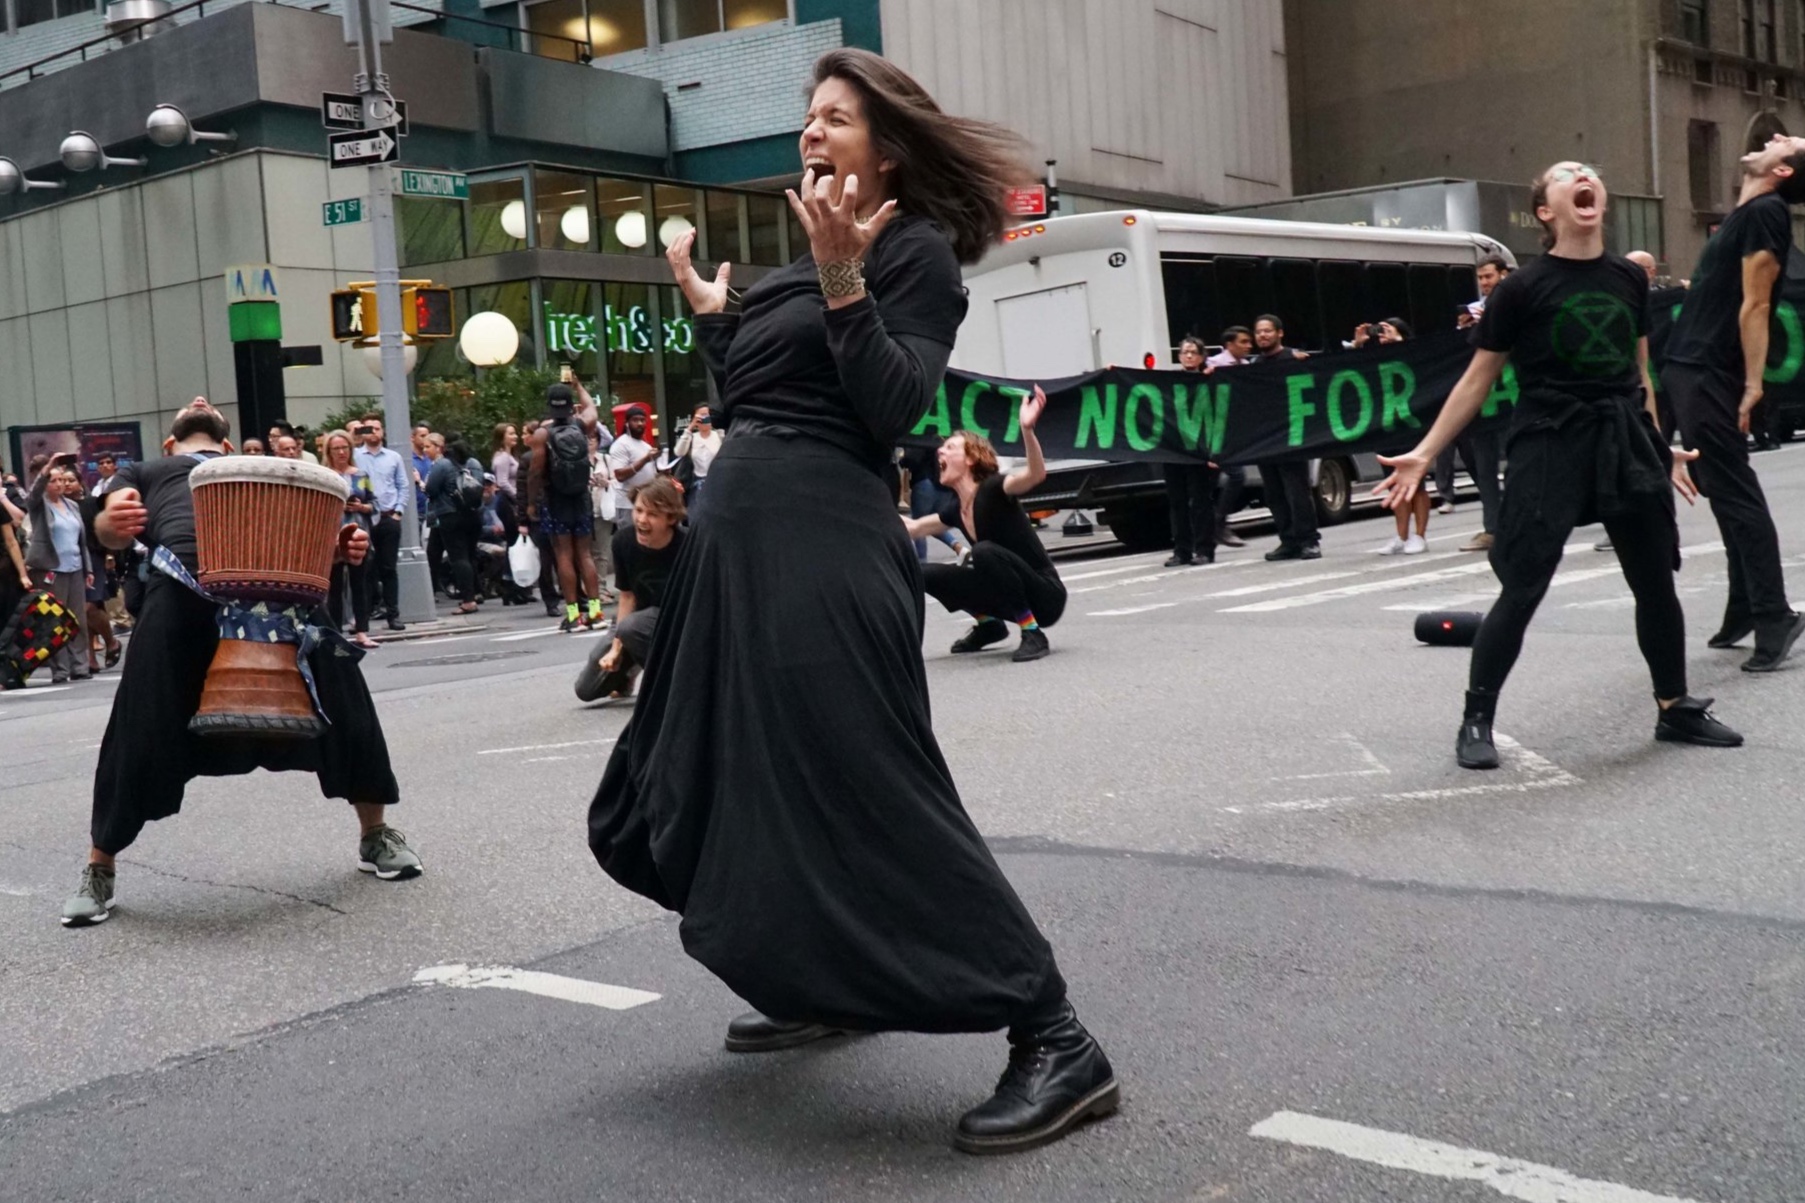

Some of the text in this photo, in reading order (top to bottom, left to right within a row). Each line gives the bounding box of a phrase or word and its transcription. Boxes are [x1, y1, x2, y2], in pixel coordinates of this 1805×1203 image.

[336, 105, 360, 120] ONE
[340, 138, 390, 158] ONE WAY
[403, 172, 456, 195] LEXINGTON
[325, 200, 358, 224] E 51 ST
[1110, 254, 1125, 266] 12
[909, 379, 1032, 443] ACT
[1074, 382, 1232, 454] NOW
[1286, 361, 1422, 447] FOR
